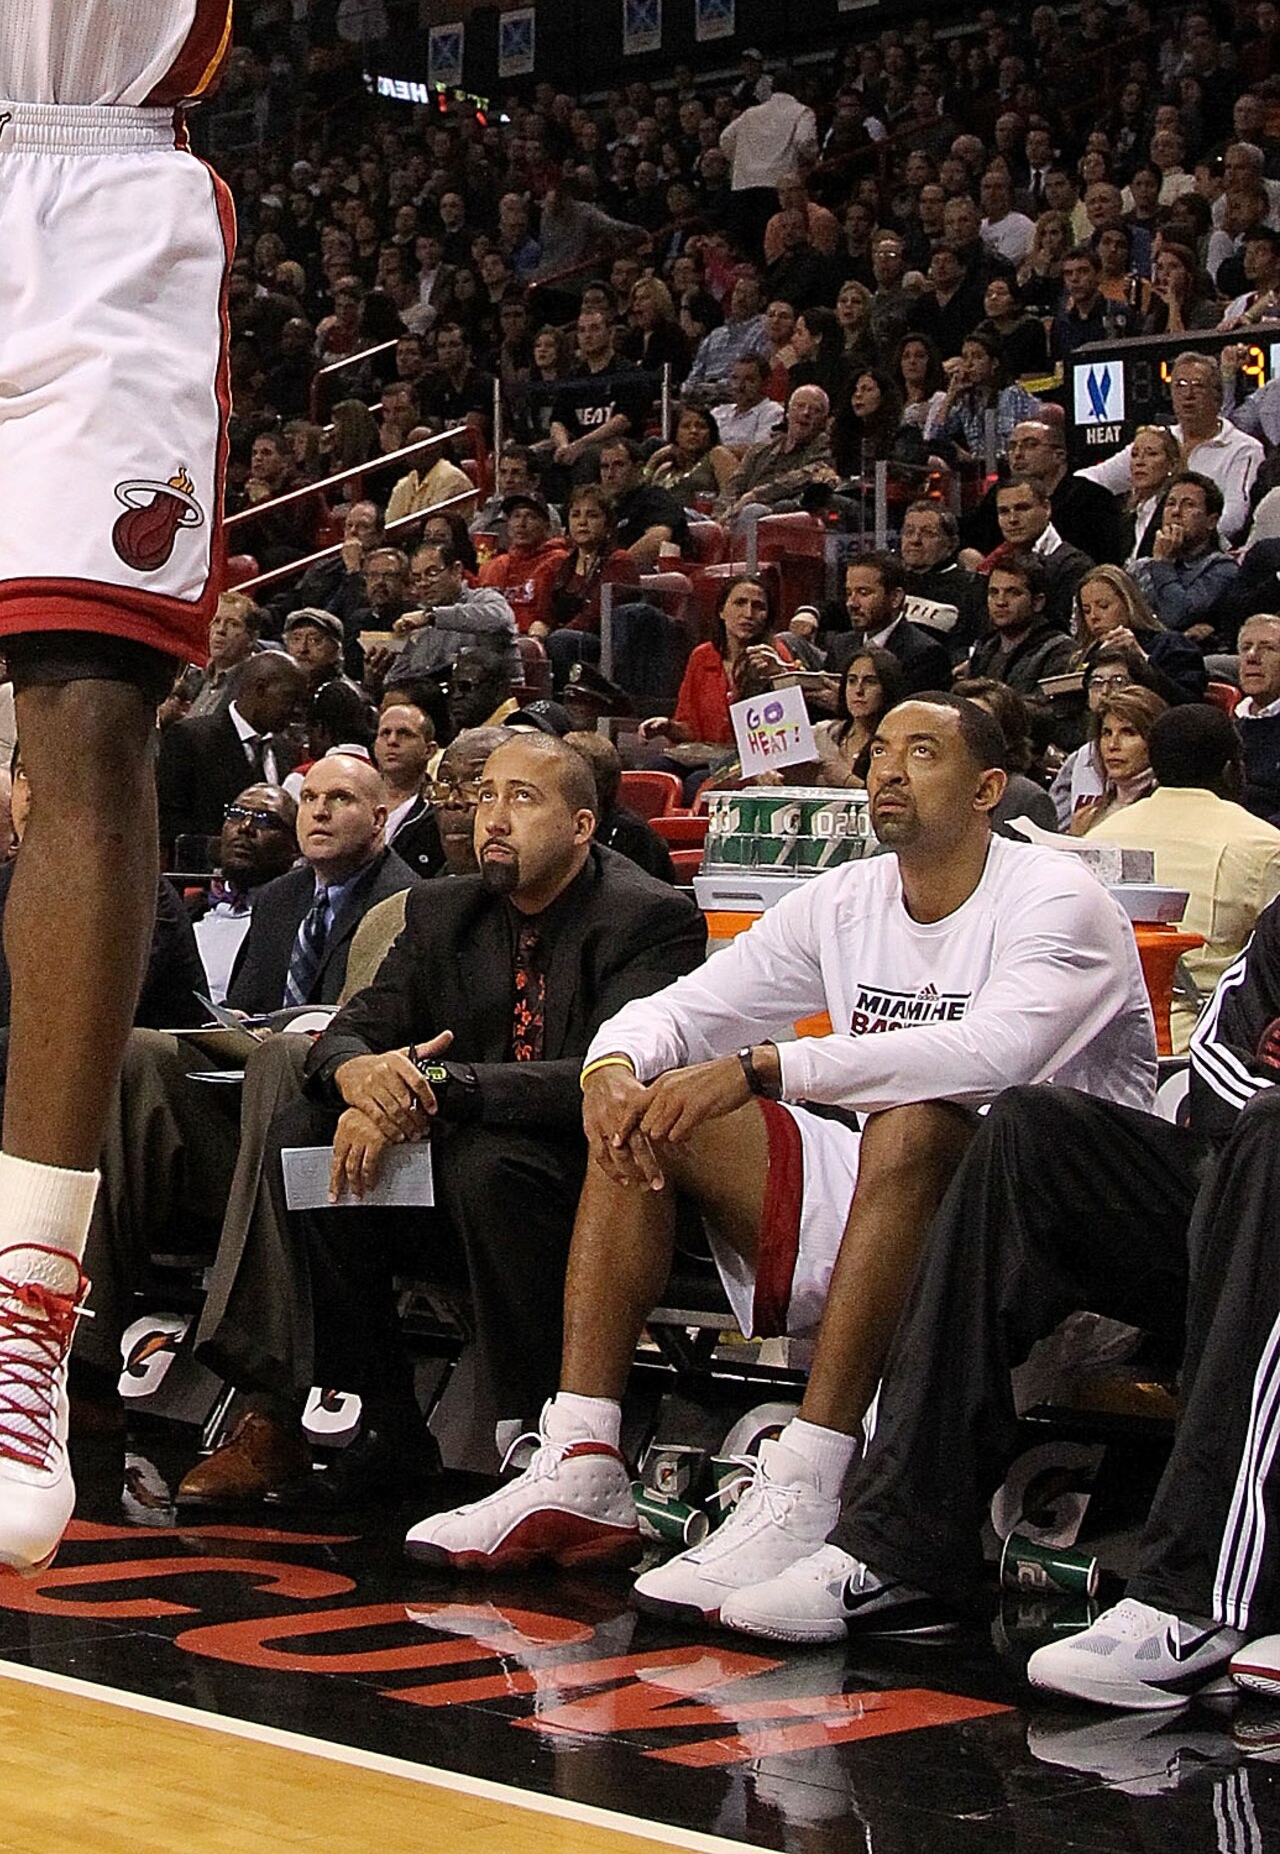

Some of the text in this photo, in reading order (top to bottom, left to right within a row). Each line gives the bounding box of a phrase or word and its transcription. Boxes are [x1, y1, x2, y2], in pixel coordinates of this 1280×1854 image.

[1086, 426, 1122, 445] HEAT
[747, 701, 783, 731] GO
[856, 992, 931, 1021] MIAMI
